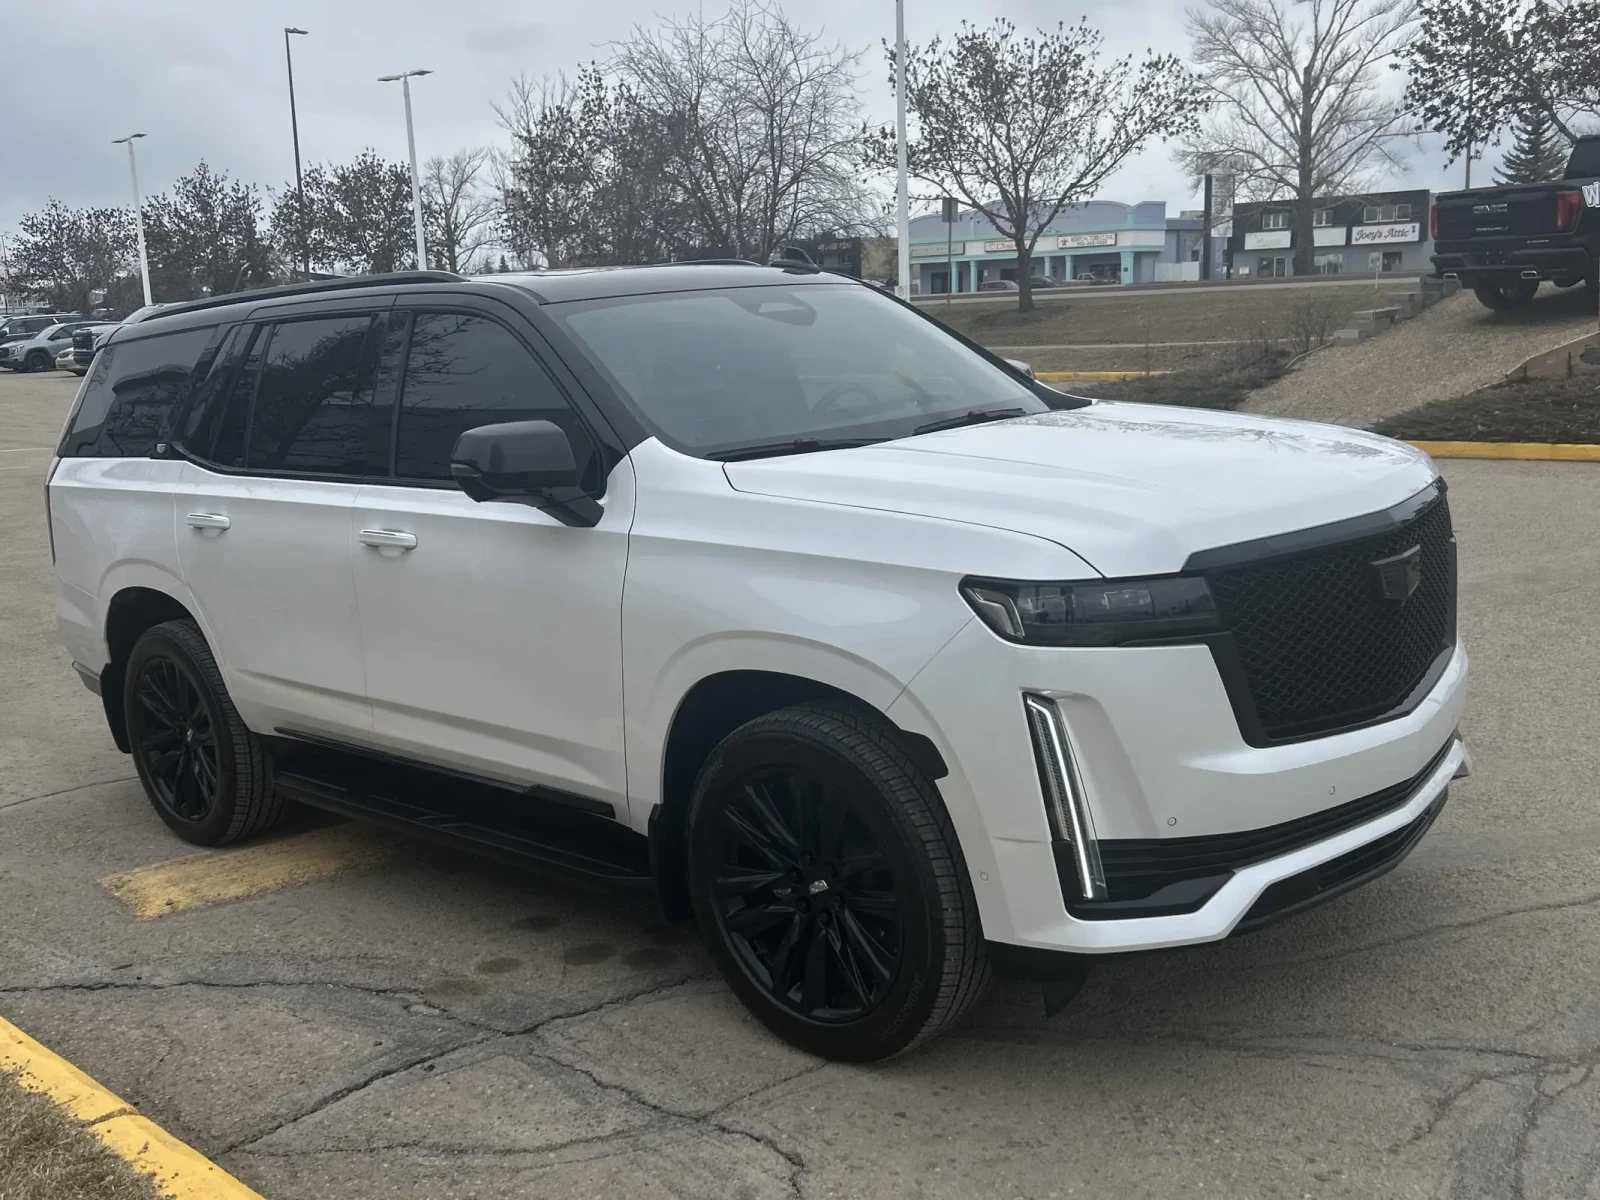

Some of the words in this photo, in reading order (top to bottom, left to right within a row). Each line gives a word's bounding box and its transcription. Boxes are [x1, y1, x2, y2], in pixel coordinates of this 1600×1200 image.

[1472, 203, 1508, 214] GMC
[1354, 229, 1383, 242] Joey's
[1384, 227, 1410, 239] Attic
